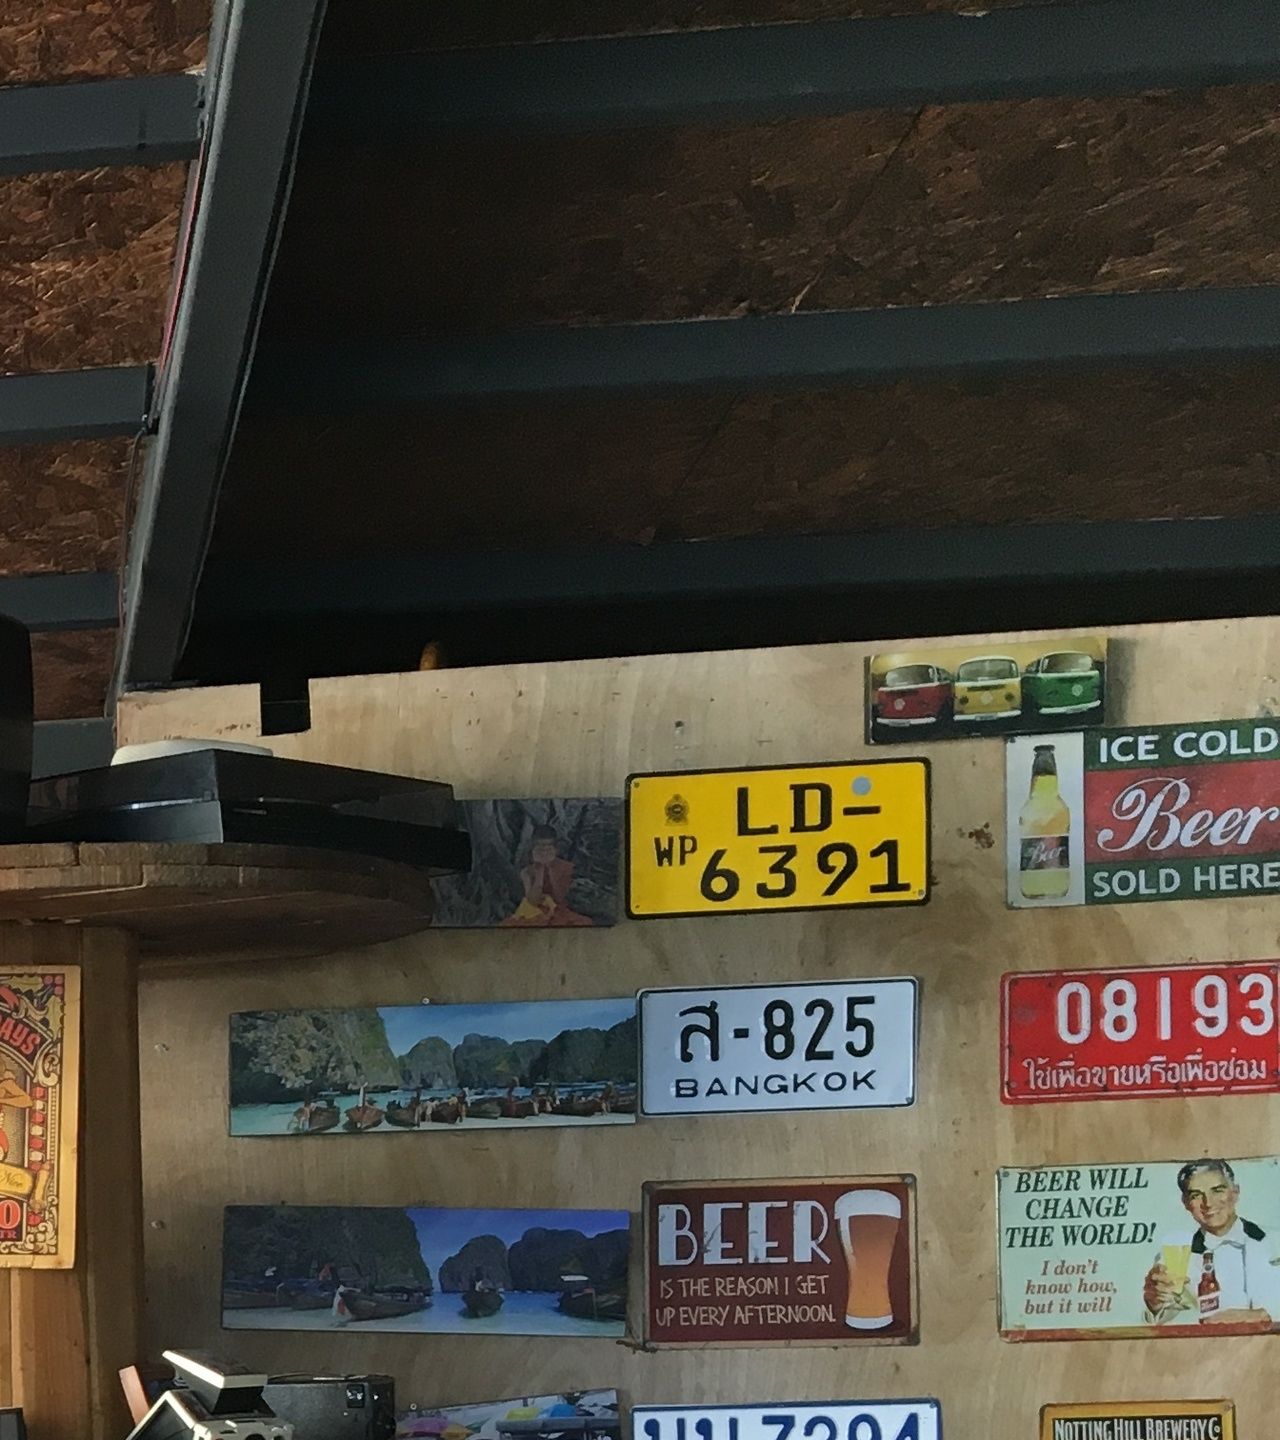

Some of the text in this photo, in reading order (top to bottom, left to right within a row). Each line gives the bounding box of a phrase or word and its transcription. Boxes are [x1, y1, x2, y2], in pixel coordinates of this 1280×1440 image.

[1099, 727, 1280, 763] ICE COLD
[1096, 777, 1280, 852] Beer
[654, 835, 697, 867] WP
[700, 839, 911, 902] 6391
[1093, 862, 1280, 897] SOLD HERE
[1054, 973, 1274, 1044] 08193
[674, 1070, 877, 1099] BANGKOK
[1014, 1167, 1149, 1194] BEER WILL
[1025, 1196, 1129, 1220] CHANGE
[658, 1201, 831, 1265] BEER
[1005, 1222, 1157, 1248] THE WORLD!
[1041, 1259, 1098, 1276] I don't
[660, 1278, 673, 1299] IS
[678, 1278, 711, 1298] THE
[715, 1276, 779, 1297] REASON
[796, 1275, 829, 1295] GET
[1025, 1278, 1118, 1295] know how,
[656, 1305, 836, 1327] UP EVERY AFTERNOON.
[1024, 1297, 1112, 1315] but it will
